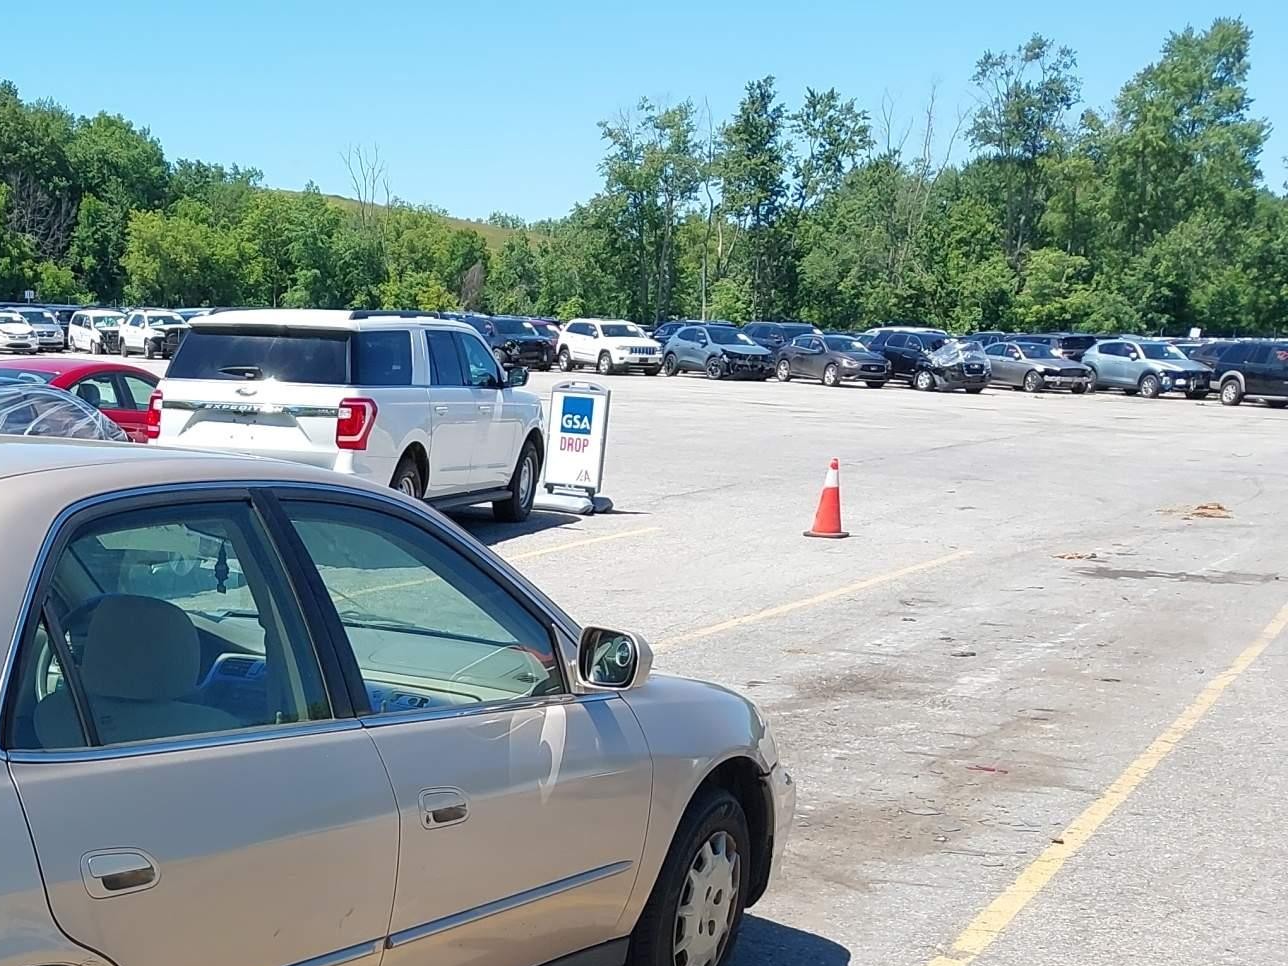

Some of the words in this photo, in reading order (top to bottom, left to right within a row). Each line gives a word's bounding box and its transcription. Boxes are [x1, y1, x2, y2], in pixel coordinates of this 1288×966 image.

[204, 404, 284, 413] EXPEDITN
[562, 413, 591, 430] GSA
[559, 436, 590, 453] DROP
